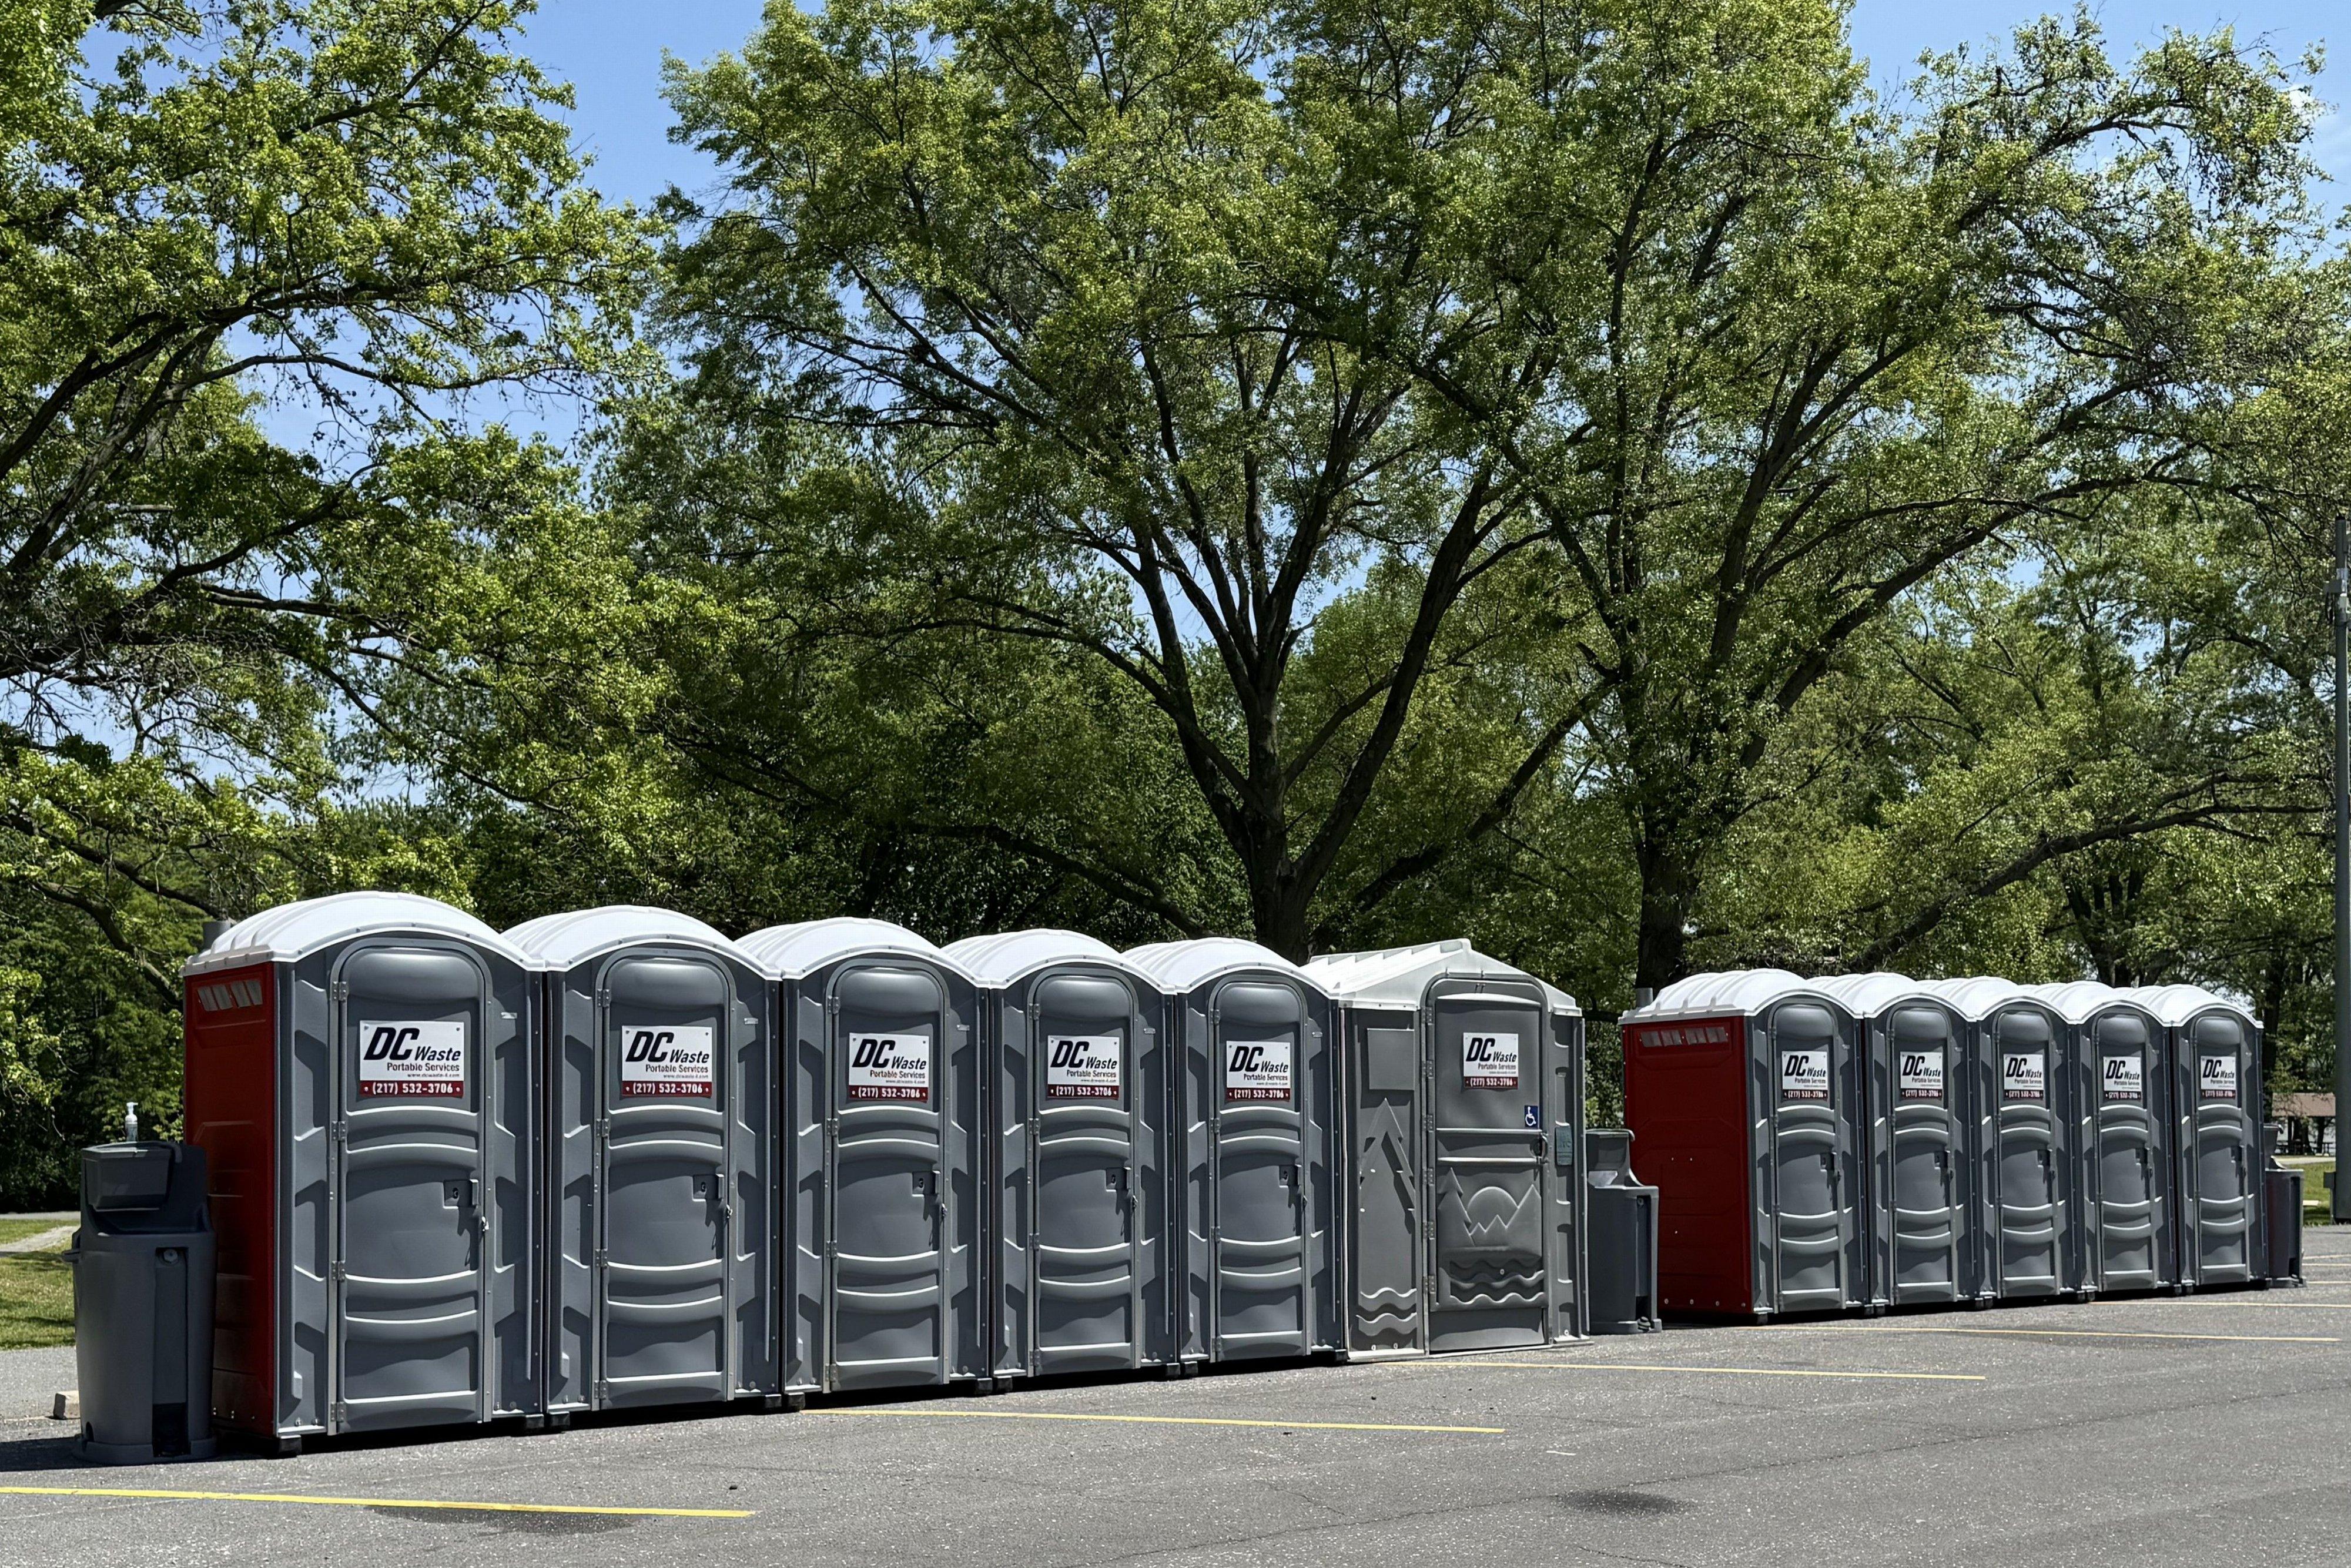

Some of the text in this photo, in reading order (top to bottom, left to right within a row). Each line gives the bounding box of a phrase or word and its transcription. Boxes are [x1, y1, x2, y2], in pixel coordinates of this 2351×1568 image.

[364, 1027, 461, 1061] DC Waste
[625, 1031, 709, 1063] DC Waste
[1466, 1037, 1517, 1062] DC Waste
[852, 1039, 926, 1070] DC Waste
[1050, 1040, 1117, 1069] DC Waste
[1229, 1046, 1288, 1073] DC Waste
[387, 1063, 460, 1071] Portable Services
[645, 1064, 677, 1073] Portable
[870, 1070, 897, 1078] Portable
[1784, 1055, 1826, 1077] DC Waste
[1903, 1056, 1925, 1076] DC
[2006, 1058, 2027, 1077] DC
[2106, 1060, 2125, 1079] DC
[2203, 1059, 2222, 1078] DC
[372, 1082, 453, 1095] (217) 532-3706
[632, 1082, 702, 1094] (217) 532-3706
[1056, 1085, 1111, 1096] (217) 532-3706
[1470, 1077, 1485, 1087] (217)
[858, 1087, 920, 1098] (217) 532-3706
[1234, 1089, 1251, 1099] (217)
